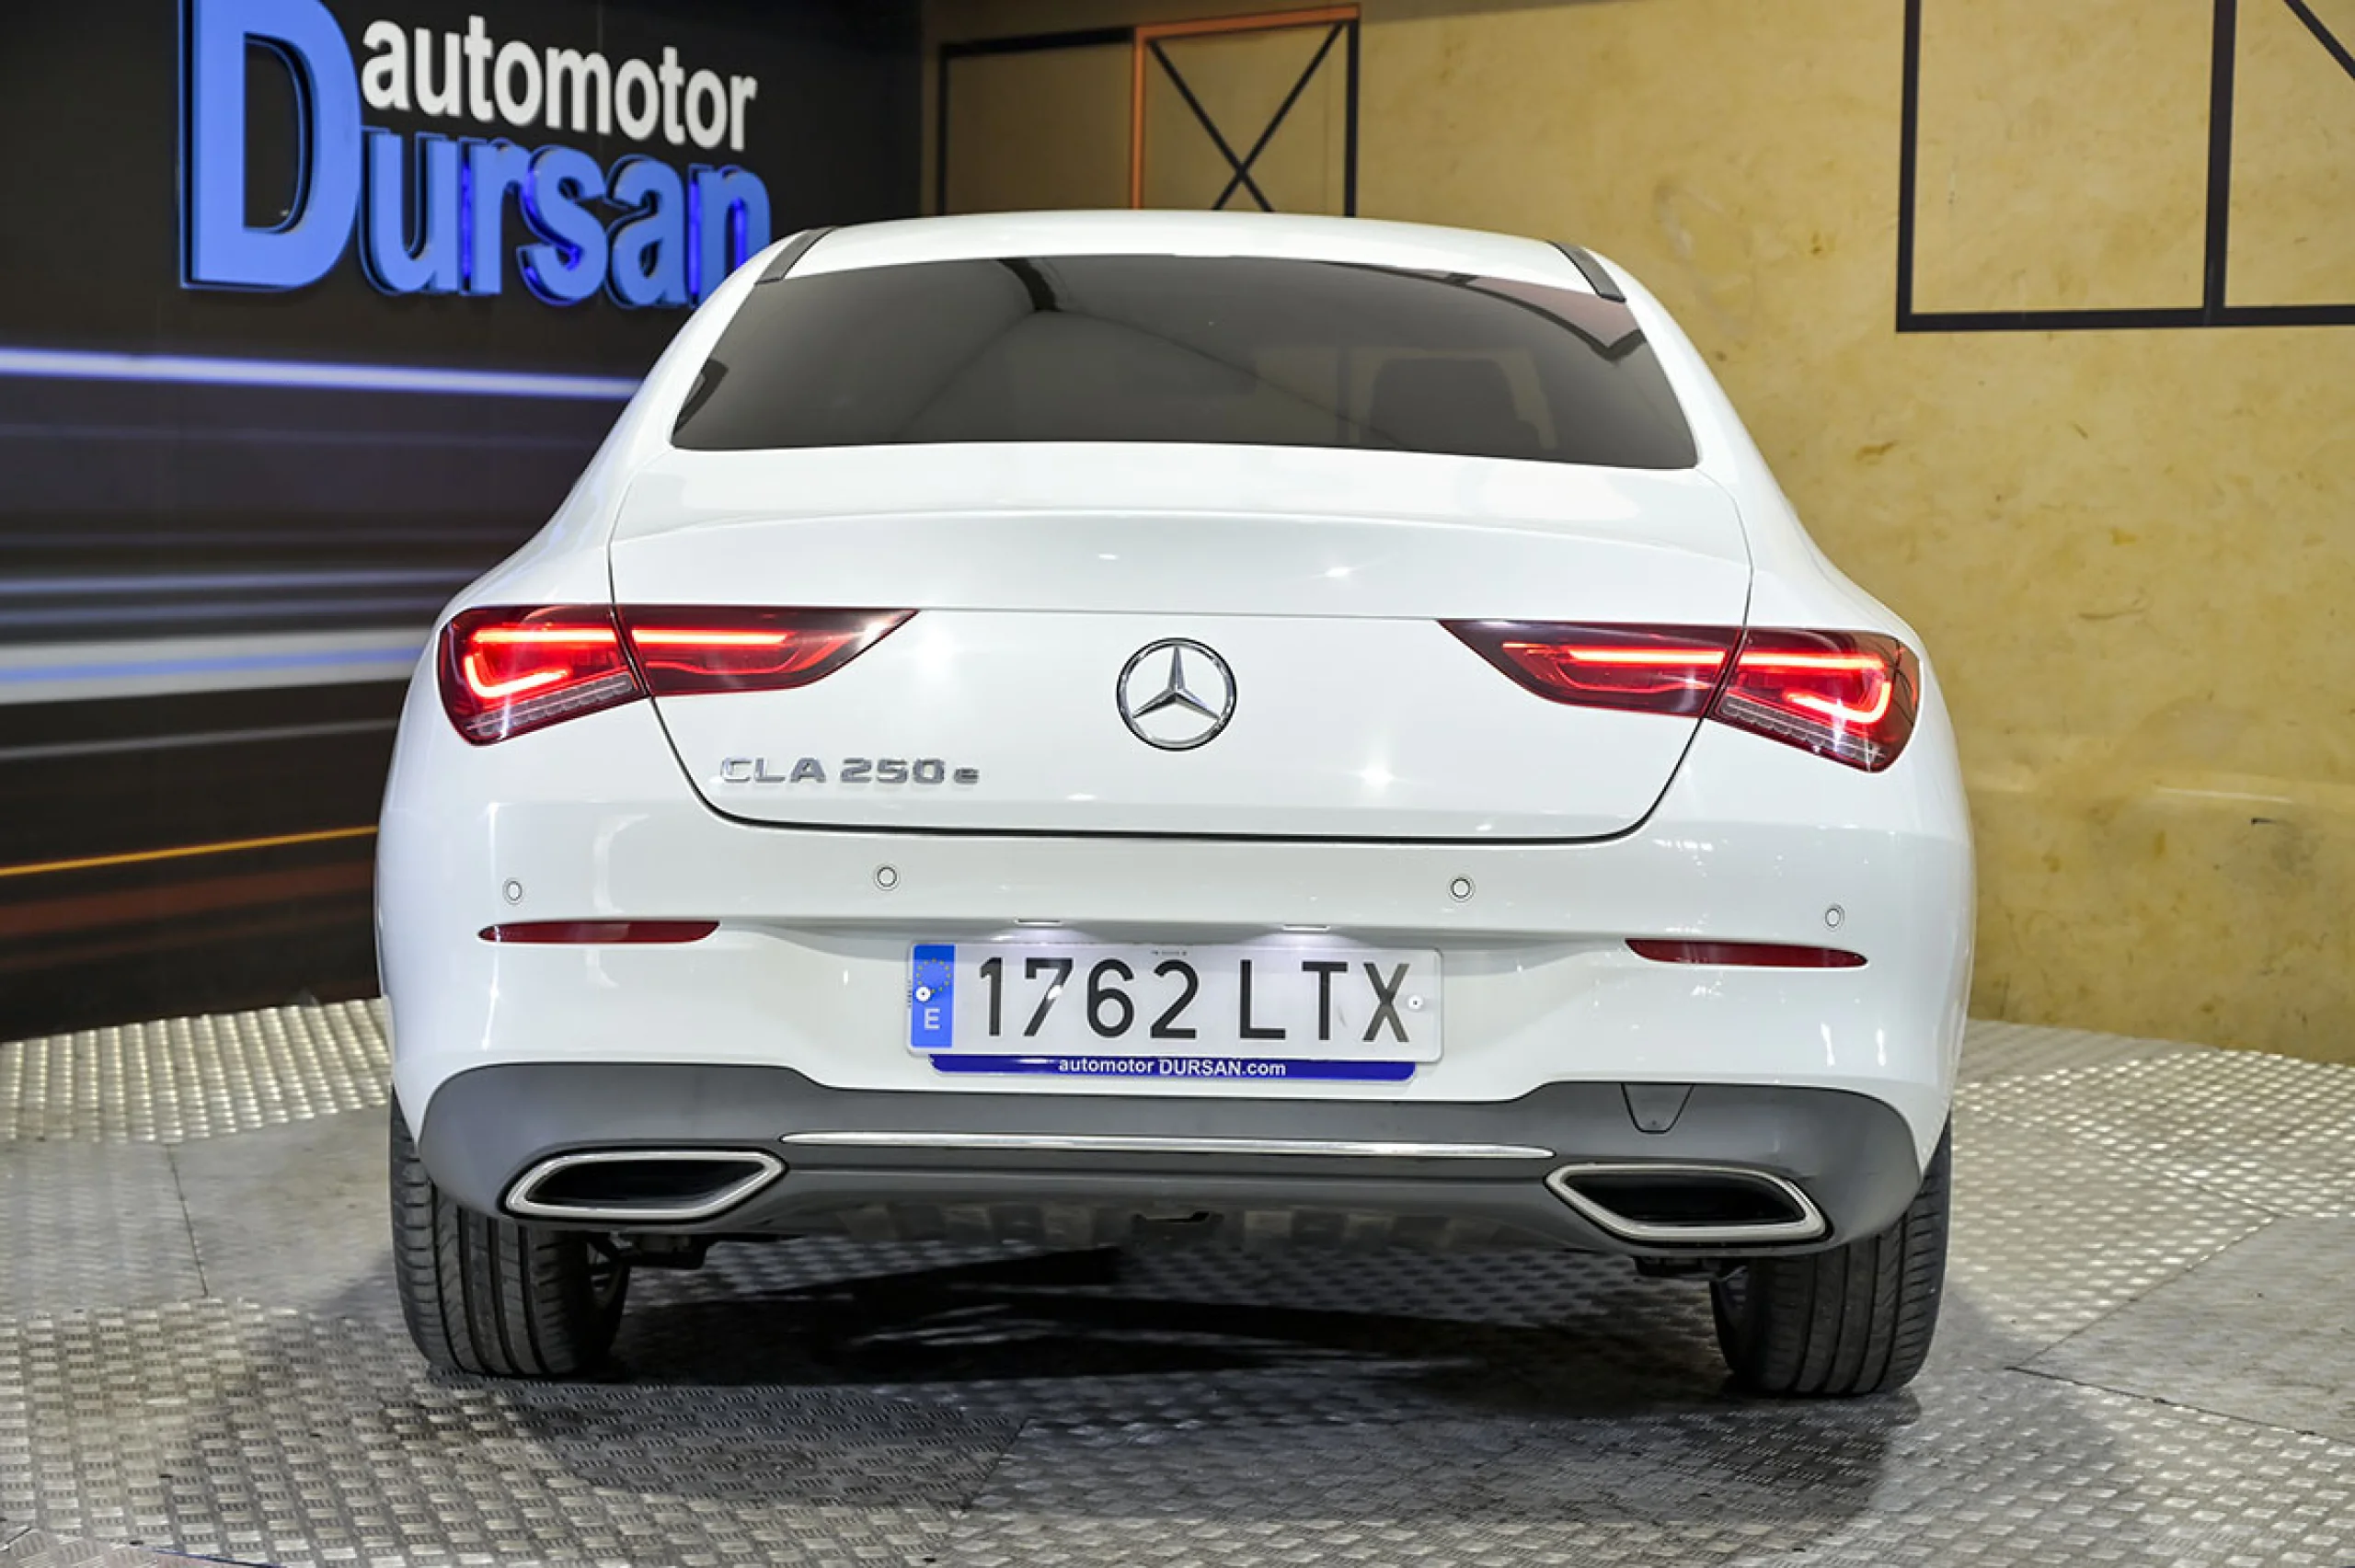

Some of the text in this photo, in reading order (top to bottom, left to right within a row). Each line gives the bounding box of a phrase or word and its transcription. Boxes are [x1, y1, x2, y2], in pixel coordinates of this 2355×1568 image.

[362, 15, 757, 152] automotor
[178, 0, 771, 308] Dursan
[720, 757, 826, 784] CLA
[924, 1007, 941, 1030] E
[979, 956, 1410, 1043] 1762 LTX
[1059, 1059, 1286, 1076] automotor DURSAN.com
